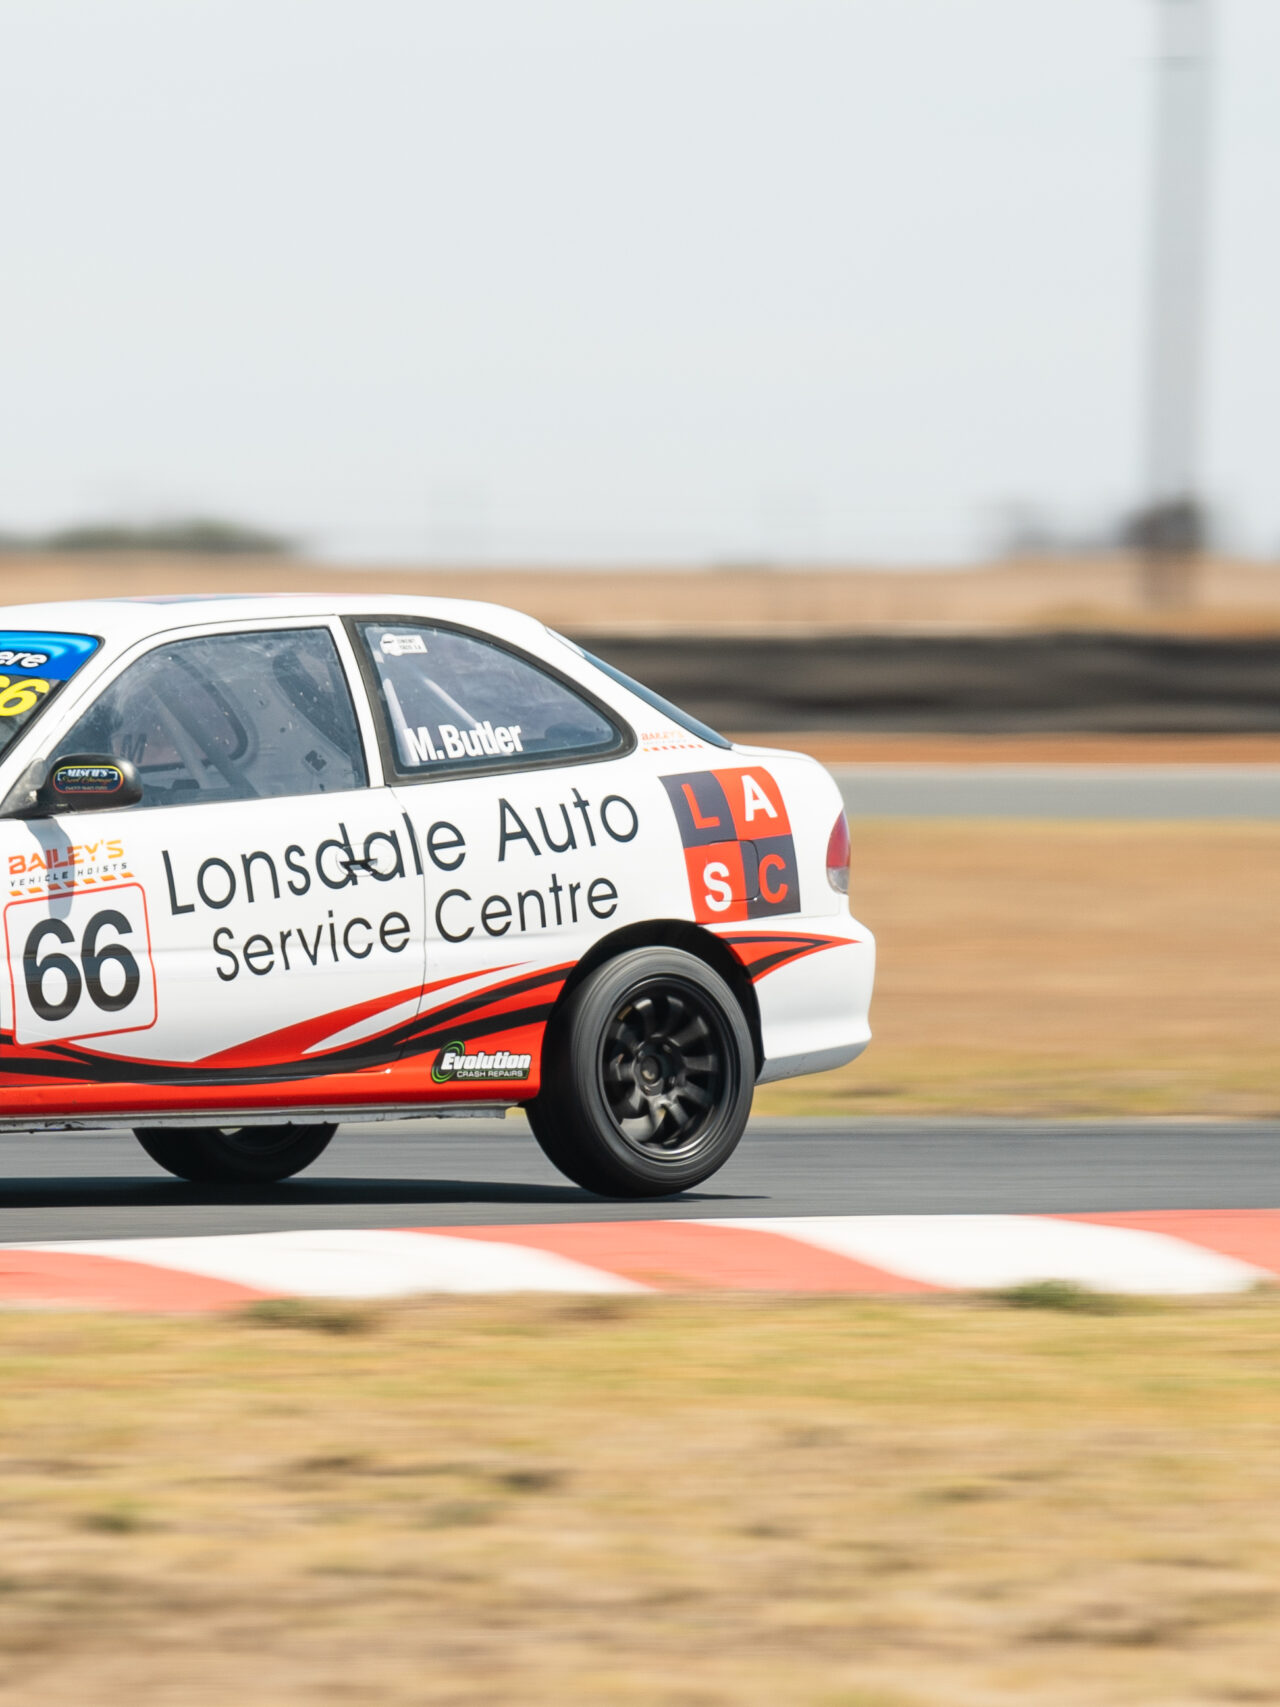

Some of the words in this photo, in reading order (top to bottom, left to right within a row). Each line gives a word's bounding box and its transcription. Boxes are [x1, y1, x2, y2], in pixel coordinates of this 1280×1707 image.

[8, 839, 125, 875] BAILEY'S
[161, 811, 466, 916] Lonsdale
[497, 787, 639, 863] Auto
[10, 871, 69, 887] VEHICLE
[77, 862, 128, 876] HOISTS
[212, 910, 411, 982] Service
[435, 873, 618, 943] Centre
[22, 909, 140, 1022] 66
[441, 1051, 532, 1070] Evolution
[456, 1070, 486, 1078] CRASH
